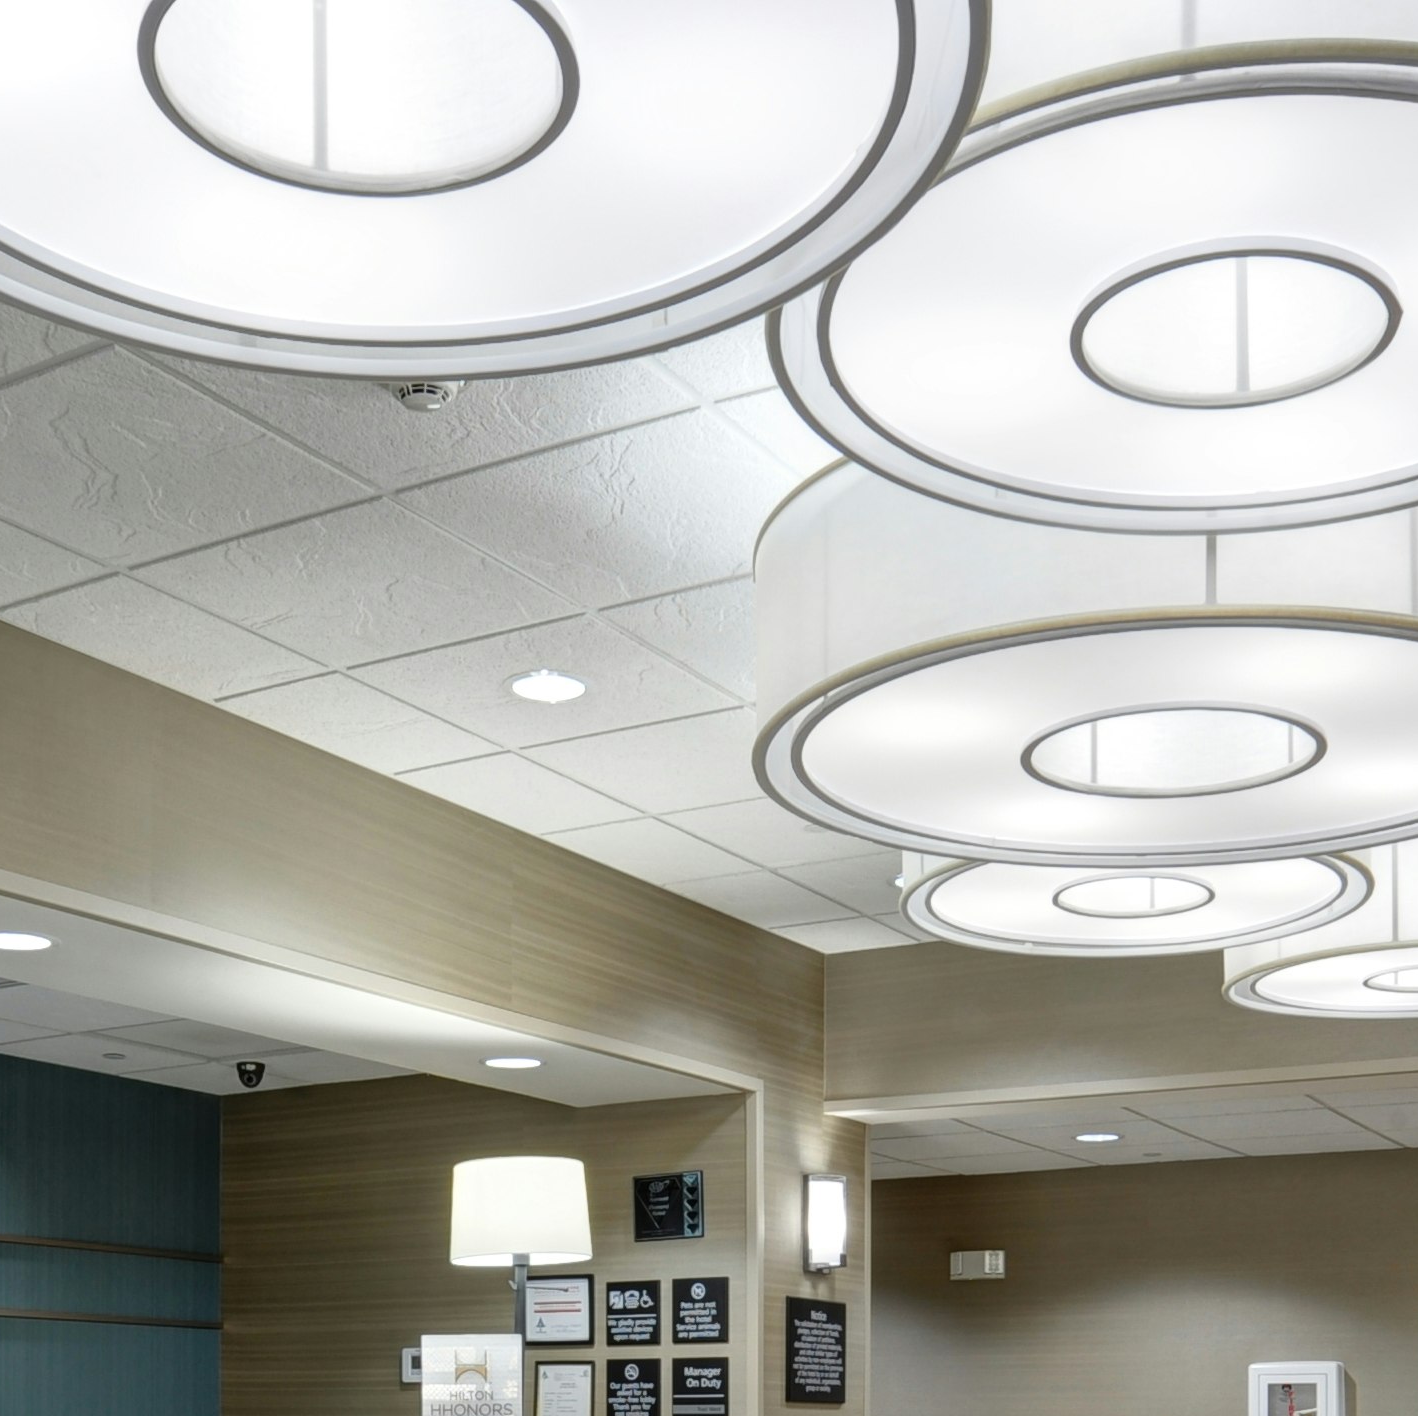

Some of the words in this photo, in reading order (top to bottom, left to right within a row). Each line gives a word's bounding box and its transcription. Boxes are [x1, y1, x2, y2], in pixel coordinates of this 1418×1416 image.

[683, 1366, 722, 1378] Manager
[686, 1378, 699, 1388] On
[700, 1378, 722, 1389] Duty
[449, 1390, 494, 1401] HILTON
[430, 1403, 514, 1416] HHONORS
